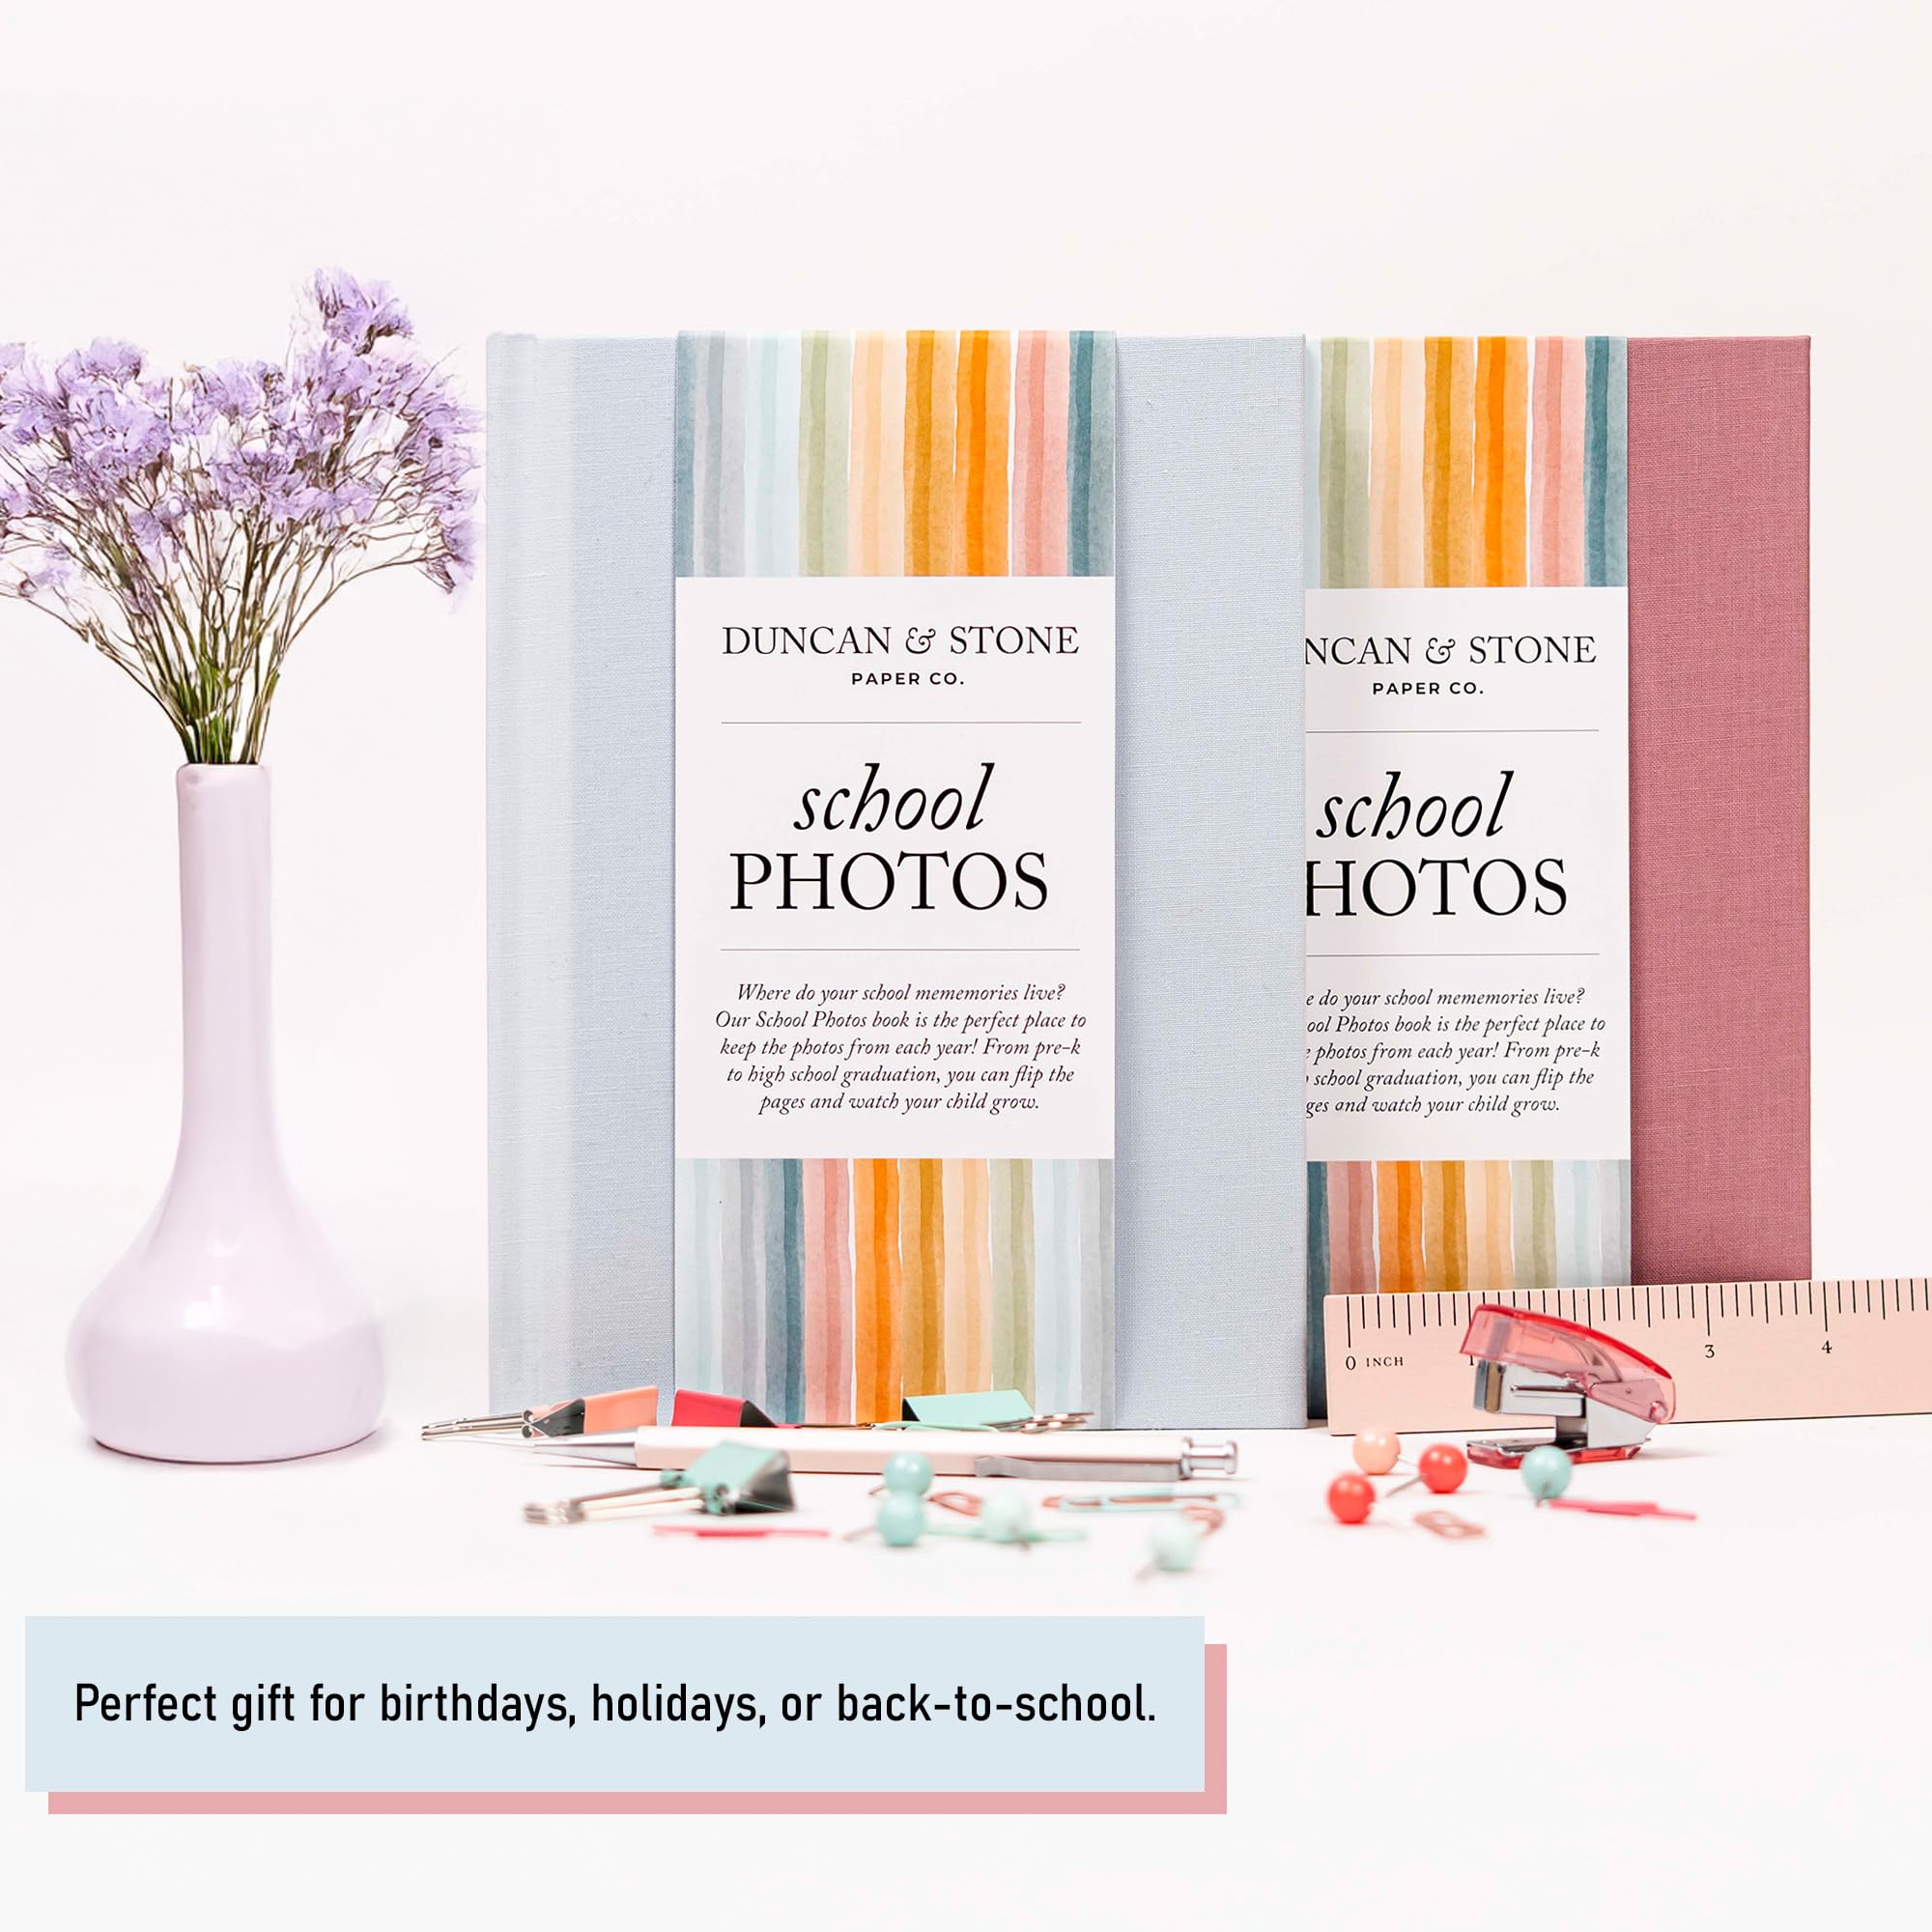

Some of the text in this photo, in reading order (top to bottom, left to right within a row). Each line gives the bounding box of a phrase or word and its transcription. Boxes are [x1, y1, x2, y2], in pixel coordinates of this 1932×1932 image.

[722, 625, 1080, 655] DUNCAN & STONE
[1304, 635, 1597, 666] NCAN & STONE
[851, 671, 964, 686] PAPER CO.
[1372, 681, 1484, 696] PAPER CO.
[792, 761, 996, 833] school
[1315, 770, 1515, 840] school
[729, 850, 1048, 911] PHOTOS
[1305, 857, 1567, 918] HOTOS
[738, 982, 1066, 1008] Where do your school mememories live?
[1319, 988, 1339, 1006] do
[1340, 994, 1381, 1012] your
[1383, 988, 1434, 1006] school
[1436, 988, 1539, 1006] mememories
[1543, 986, 1586, 1005] live?
[715, 1009, 1087, 1035] Our School Photos book is the perfect place to
[1306, 1013, 1606, 1038] ool Photos book is the perfect place to
[720, 1037, 1081, 1062] keep the photos from each year! From pre-k
[1312, 1041, 1368, 1066] photos
[1366, 1041, 1412, 1065] from
[1417, 1041, 1453, 1059] each
[1455, 1040, 1500, 1065] year!
[1503, 1040, 1550, 1058] From
[1552, 1040, 1601, 1065] pre-k
[726, 1065, 1075, 1089] to high school graduation, you can flip the
[1313, 1068, 1363, 1087] school
[1363, 1068, 1463, 1093] graduation,
[1465, 1073, 1497, 1092] you
[1501, 1073, 1530, 1085] can
[1529, 1067, 1564, 1092] flip
[1568, 1067, 1595, 1085] the
[757, 1092, 1039, 1116] pages and watch your child grow.
[1305, 1094, 1560, 1120] ges and watch your child grow.
[1345, 1355, 1356, 1371] 0
[1366, 1356, 1404, 1368] INCH
[1704, 1344, 1716, 1359] 3
[1821, 1340, 1833, 1354] 4
